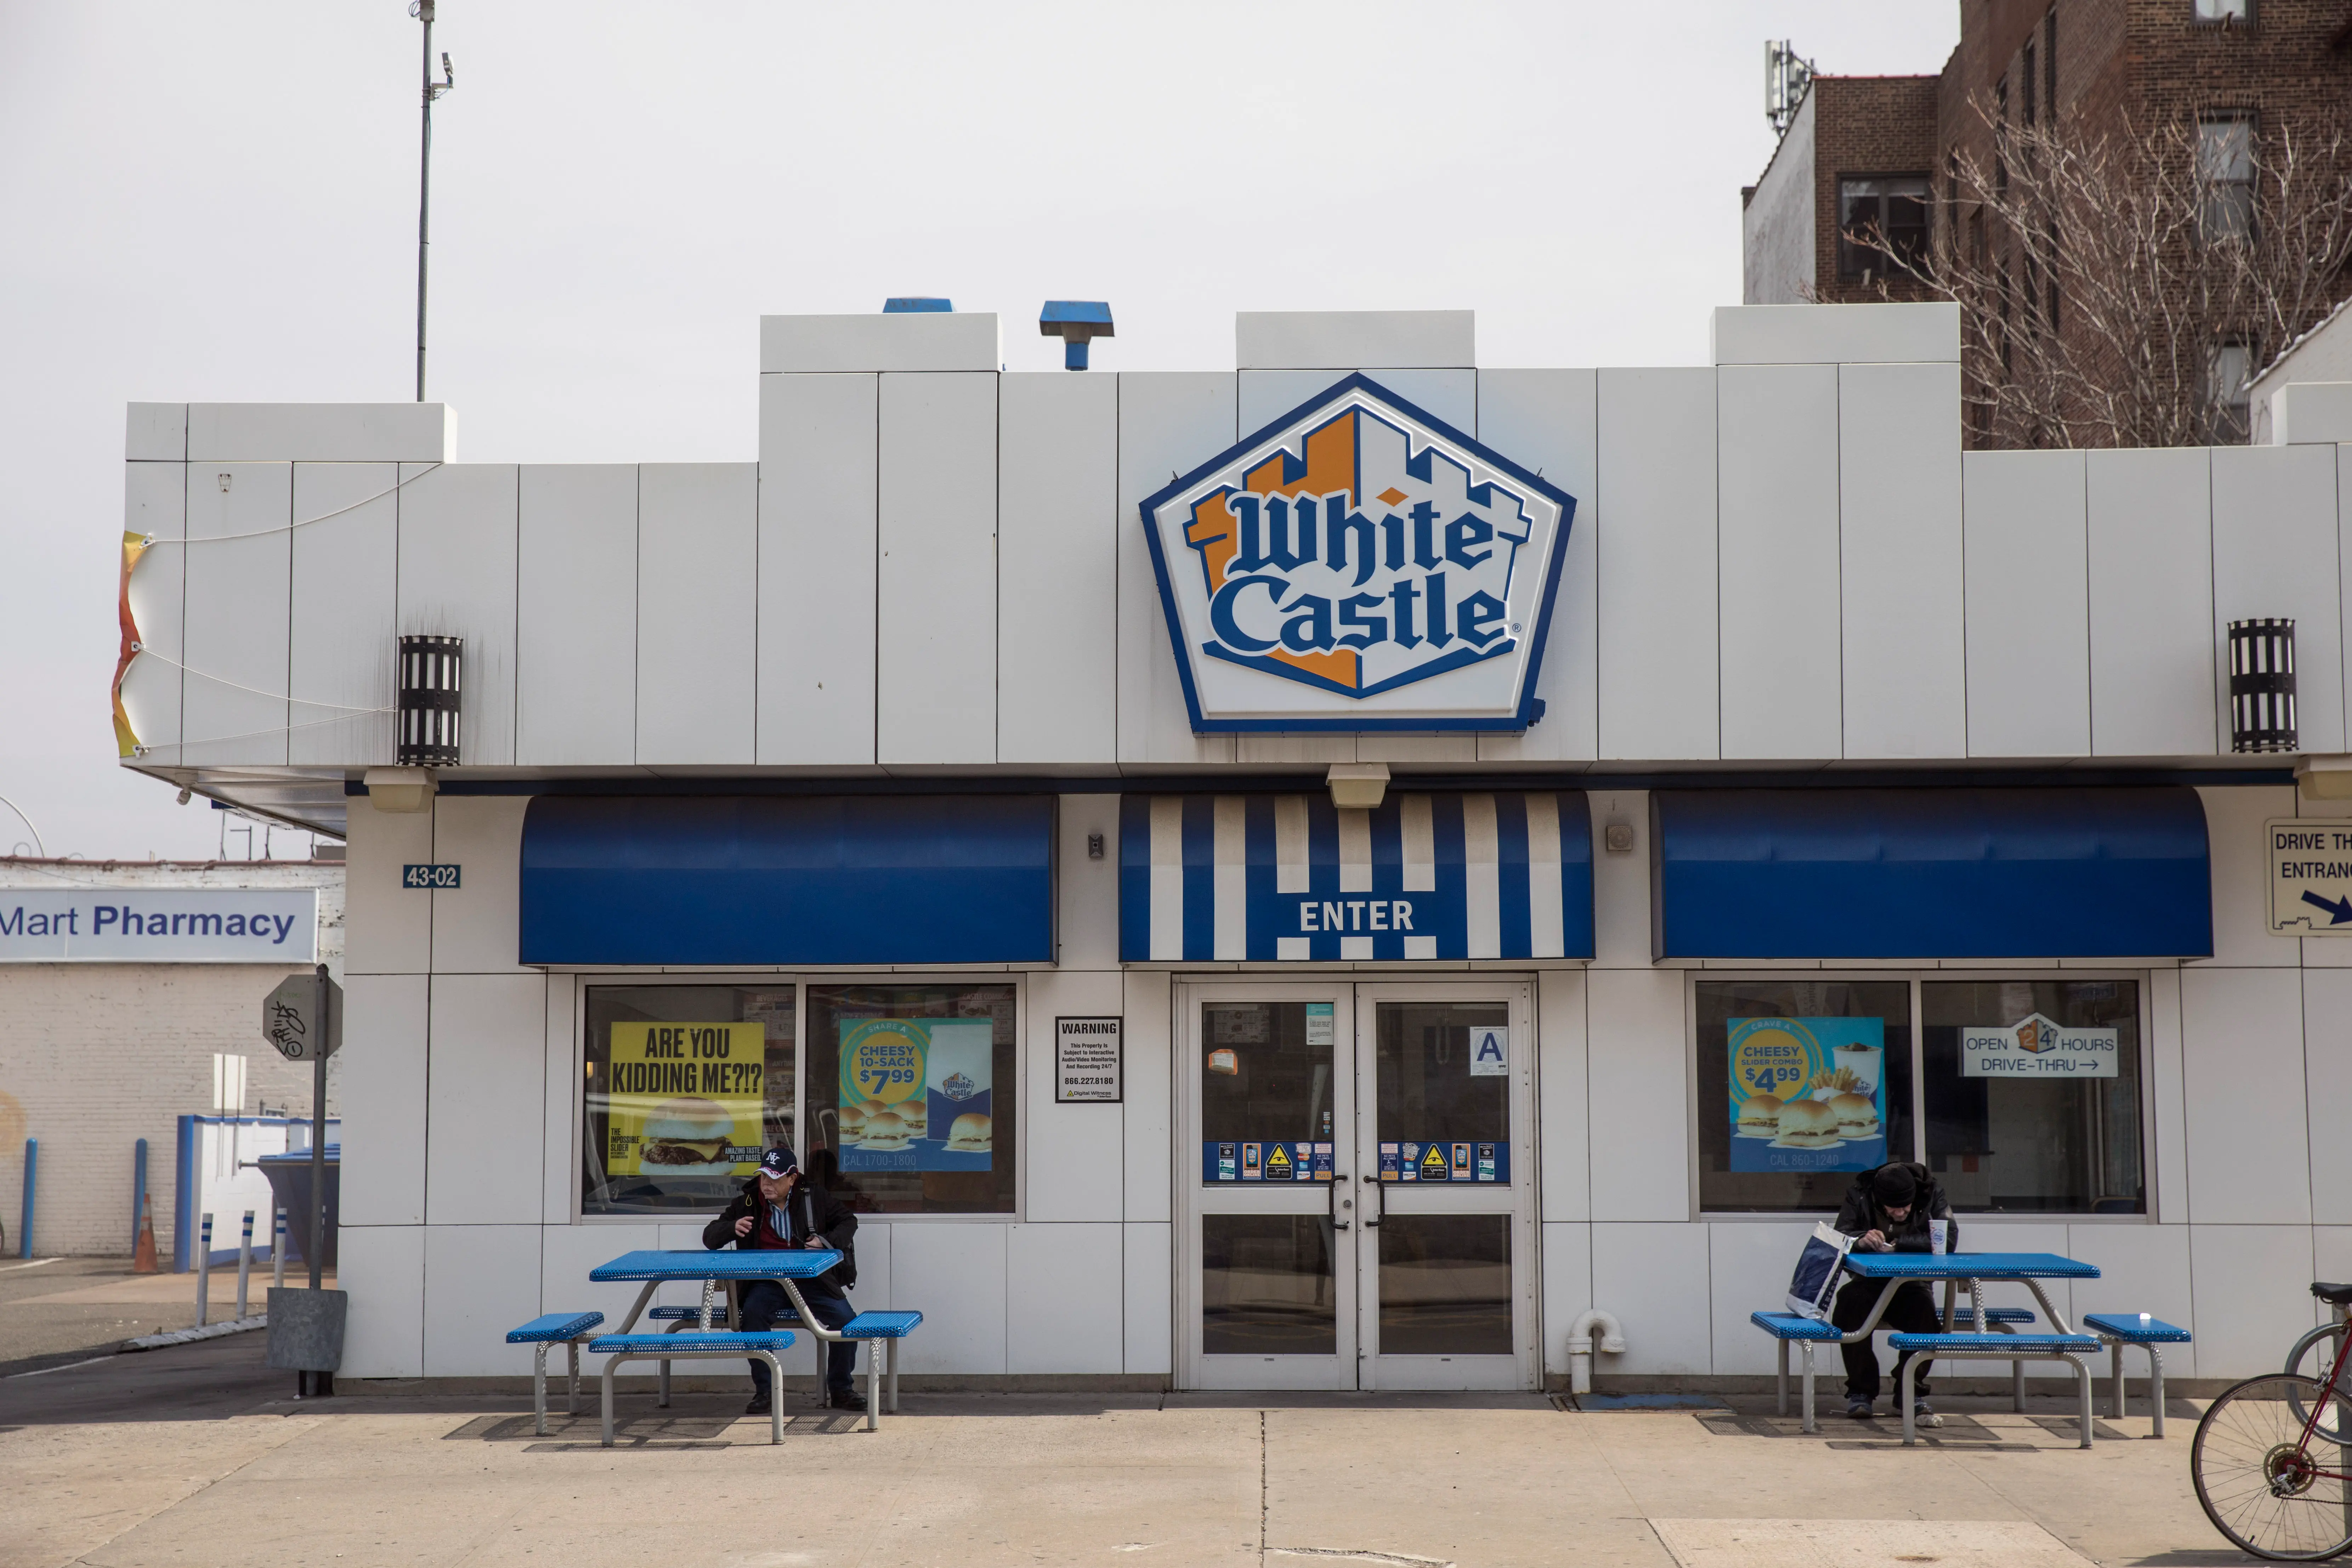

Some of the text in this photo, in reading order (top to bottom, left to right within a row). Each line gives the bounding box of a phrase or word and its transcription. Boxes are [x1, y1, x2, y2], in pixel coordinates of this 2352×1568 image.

[1227, 493, 1493, 587] White
[1210, 571, 1505, 652] Castle
[2276, 834, 2325, 850] DRIVE
[407, 867, 456, 886] 43-02
[2282, 862, 2352, 878] ENTRAN
[1300, 901, 1414, 931] ENTER
[0, 906, 295, 945] Mart Pharmacy
[868, 1023, 898, 1033] SHARE
[1062, 1023, 1116, 1034] WARNING
[1751, 1020, 1782, 1030] CRAVE
[645, 1028, 730, 1059] ARE YOU
[1476, 1032, 1503, 1061] A
[1966, 1030, 2114, 1051] OPEN 24 HOURS
[860, 1046, 915, 1056] CHEESY
[1743, 1046, 1800, 1057] CHEESY
[859, 1057, 915, 1067] 10-SACK
[1982, 1059, 2076, 1071] DRIVE-THRU
[612, 1063, 762, 1093] KIDDING ME?!?
[946, 1081, 970, 1090] White
[766, 1152, 780, 1165] NY
[843, 1154, 916, 1166] CAL 1700-1800
[1770, 1154, 1839, 1165] CAL 860-1240
